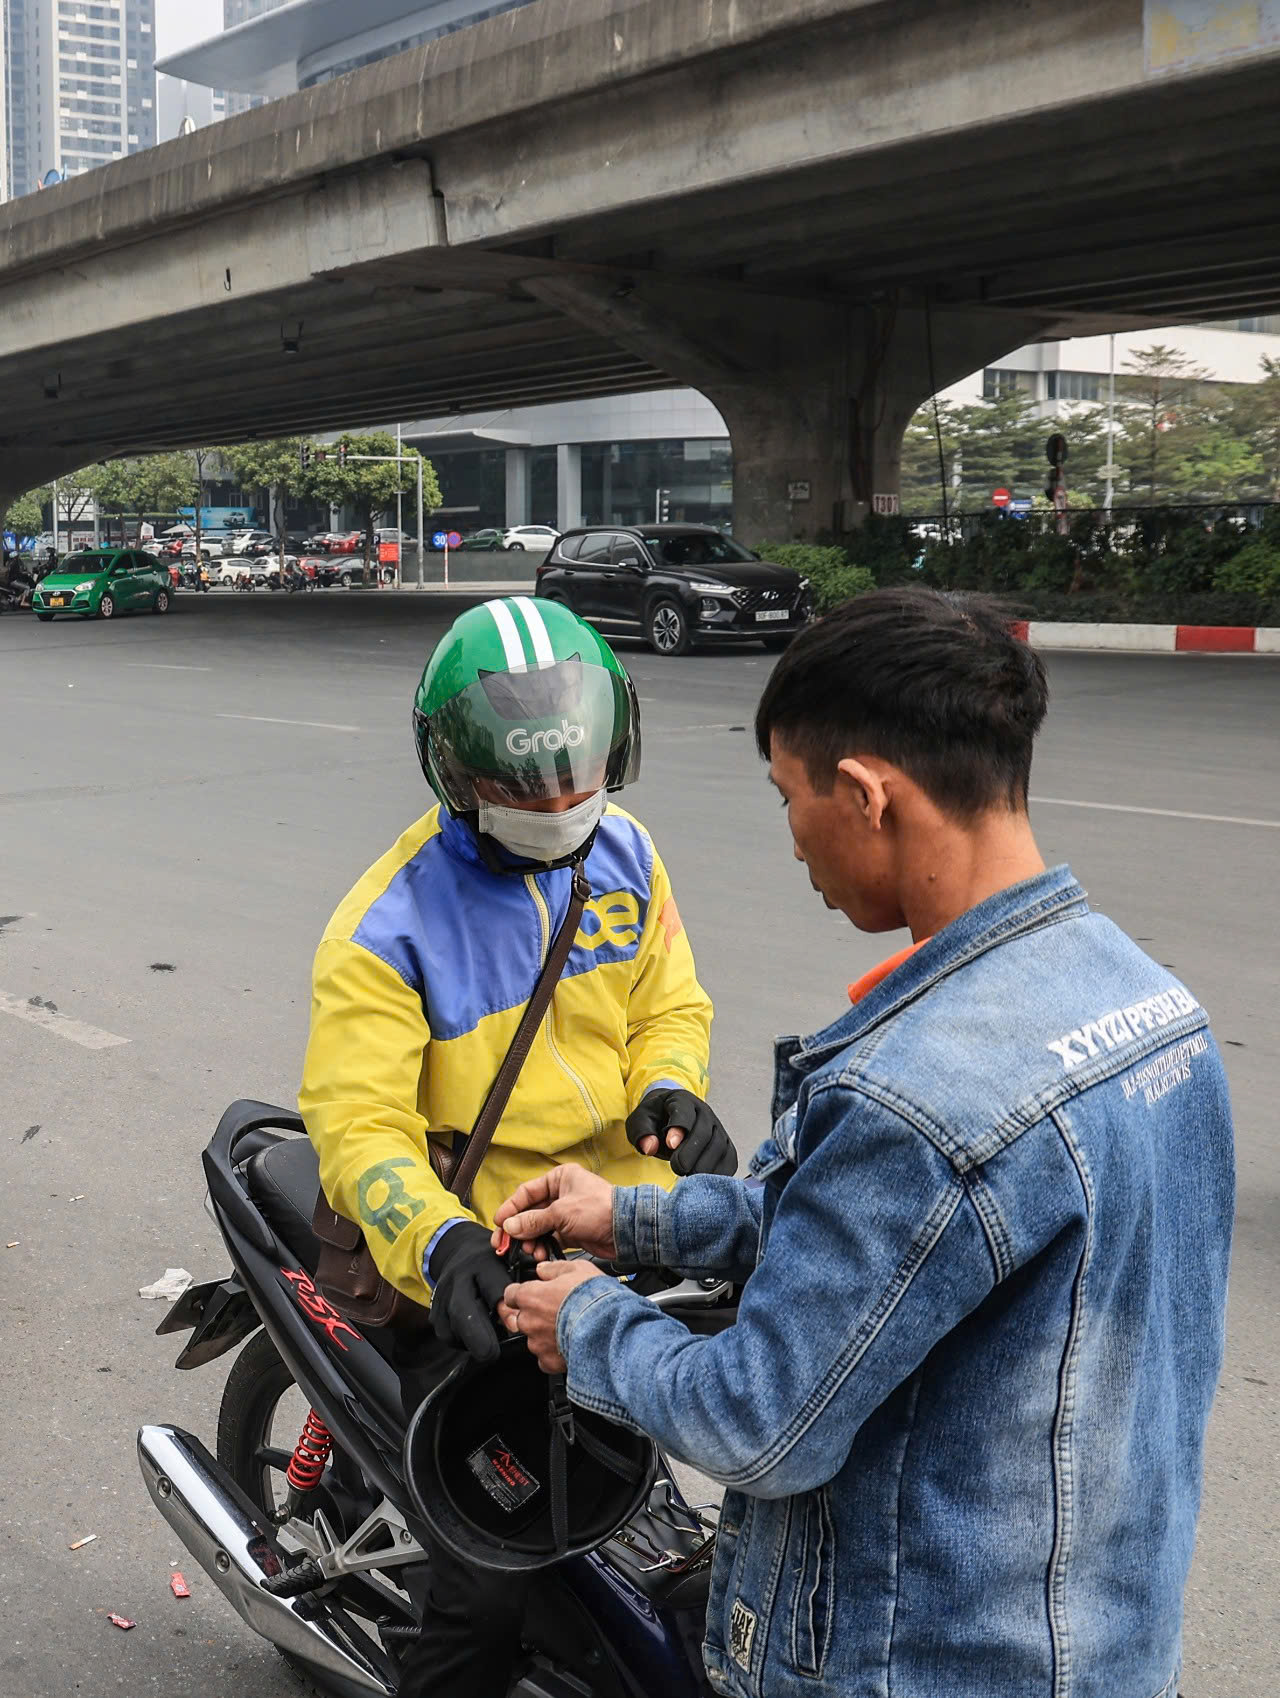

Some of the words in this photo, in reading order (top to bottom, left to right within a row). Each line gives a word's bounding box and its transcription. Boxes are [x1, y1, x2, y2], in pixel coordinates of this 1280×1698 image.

[435, 535, 446, 546] 30
[506, 719, 585, 756] Grab
[492, 1459, 516, 1487] WARNING
